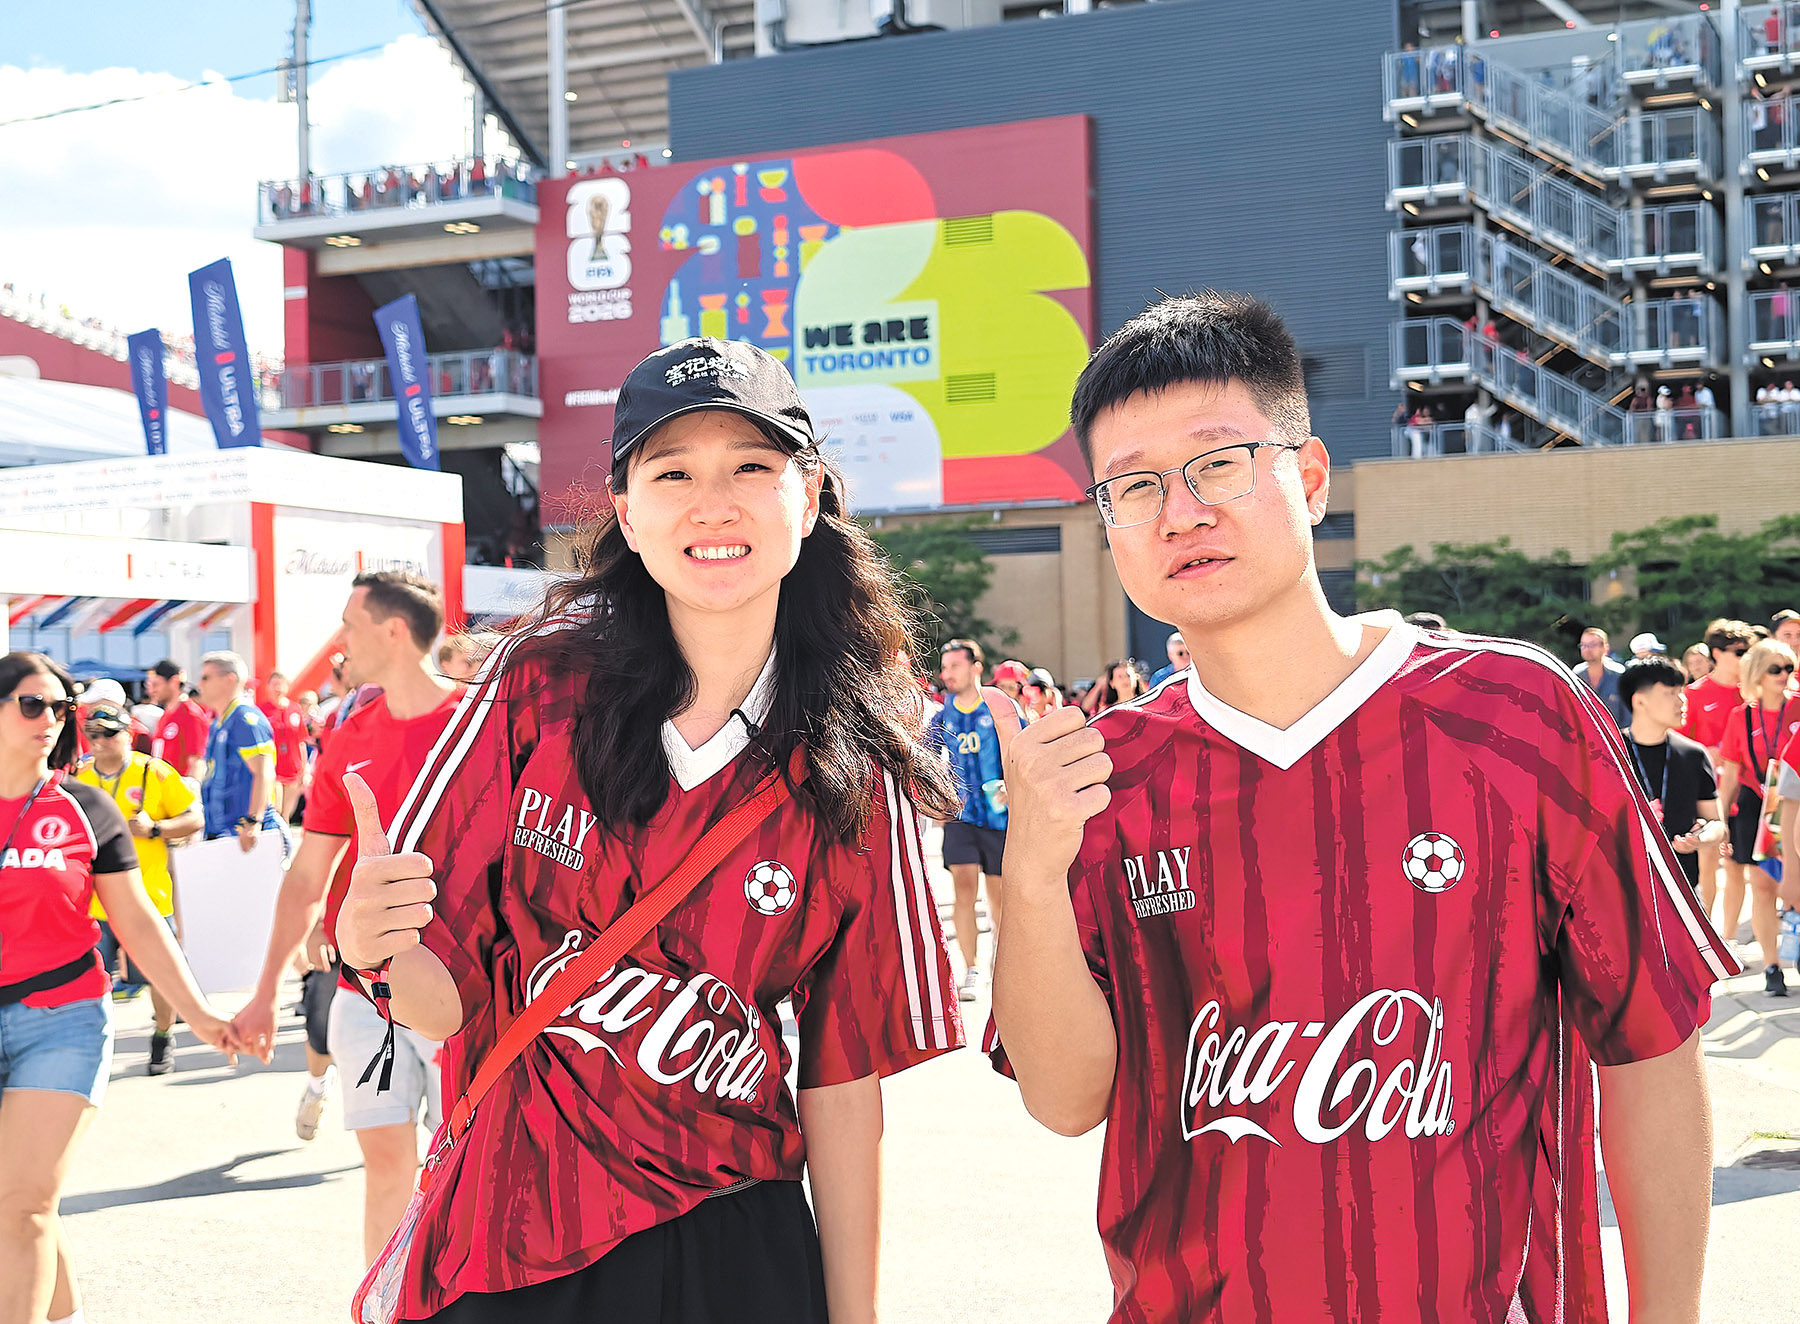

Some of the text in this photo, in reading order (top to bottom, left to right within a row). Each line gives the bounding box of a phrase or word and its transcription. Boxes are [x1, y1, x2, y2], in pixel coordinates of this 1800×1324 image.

[568, 300, 633, 323] 2026
[805, 324, 853, 348] WE
[805, 346, 930, 373] TORONTO
[218, 365, 245, 438] ULTRA
[408, 397, 433, 461] ULTRA
[958, 731, 980, 754] 20
[516, 787, 598, 852] PLAY
[513, 827, 584, 871] REFRESHED
[1123, 846, 1191, 900] PLAY
[1132, 890, 1197, 919] REFRESHED
[1180, 987, 1455, 1148] Coca-Cola
